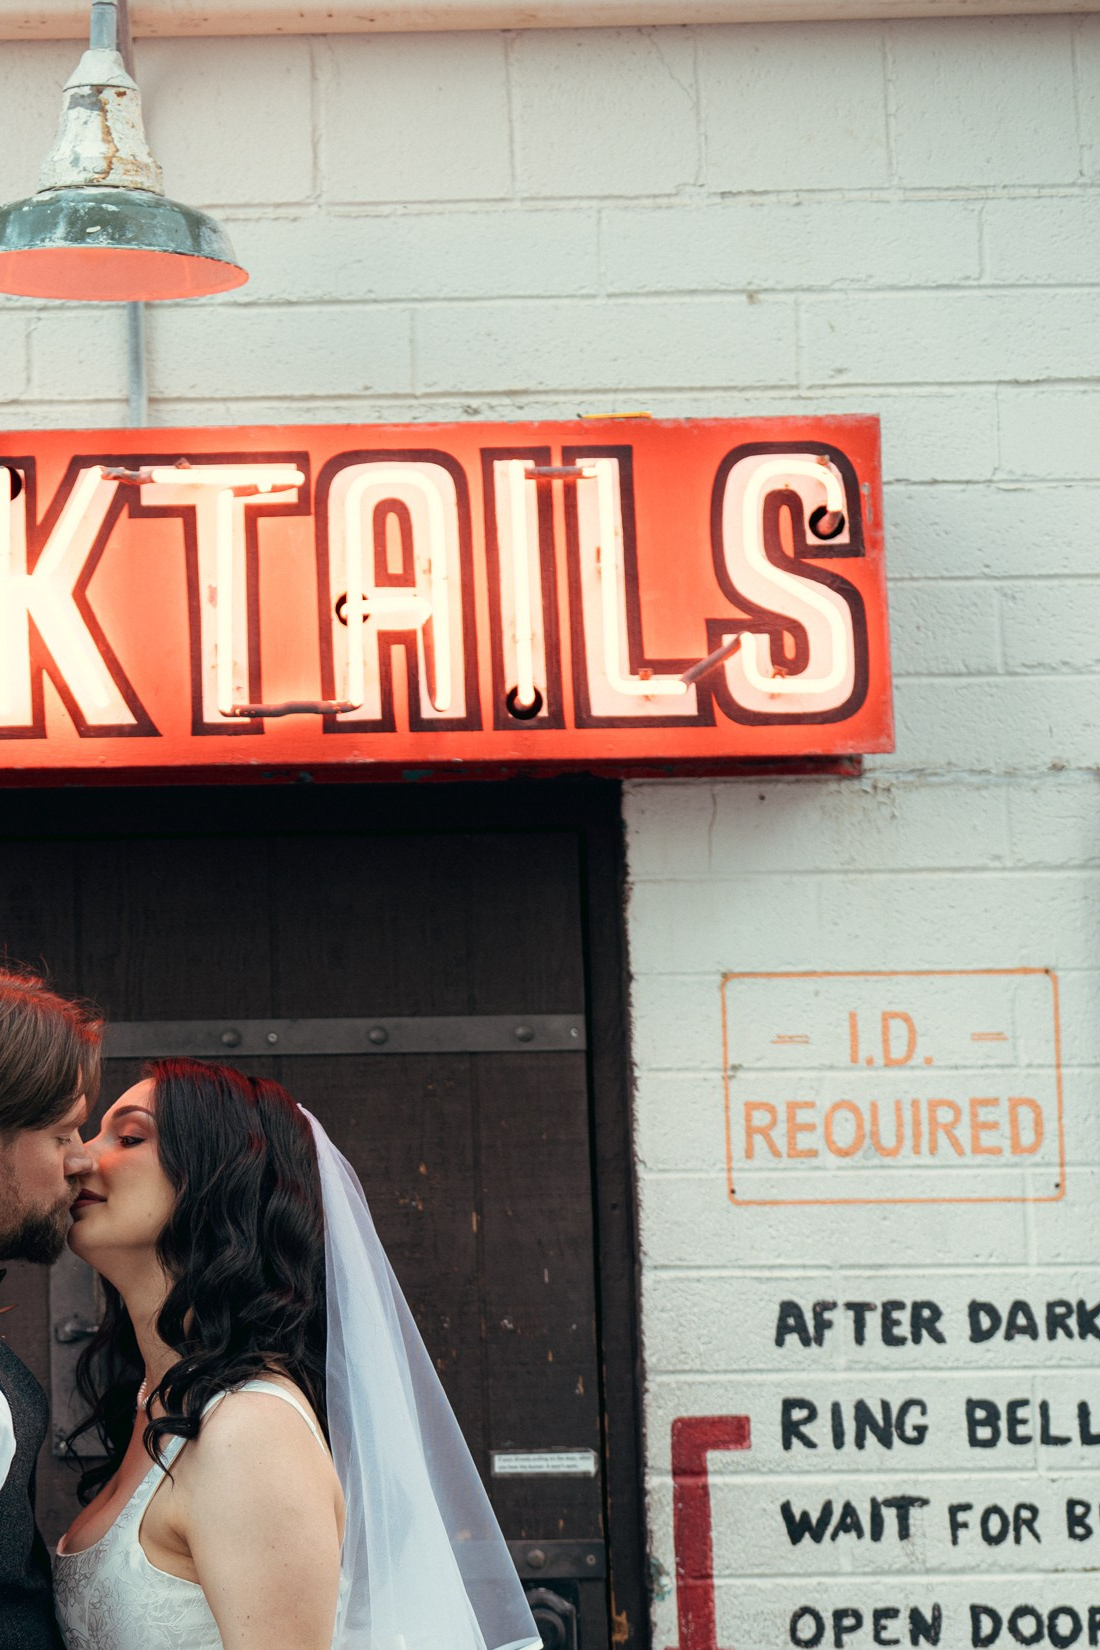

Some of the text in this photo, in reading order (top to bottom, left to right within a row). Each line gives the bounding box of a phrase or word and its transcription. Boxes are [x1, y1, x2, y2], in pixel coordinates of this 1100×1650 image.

[849, 1011, 932, 1066] I.D.
[775, 1300, 1100, 1347] AFTER DARK
[781, 1398, 1100, 1451] RING BELL
[781, 1495, 1100, 1546] WAIT FOR B
[790, 1604, 942, 1649] OPEN
